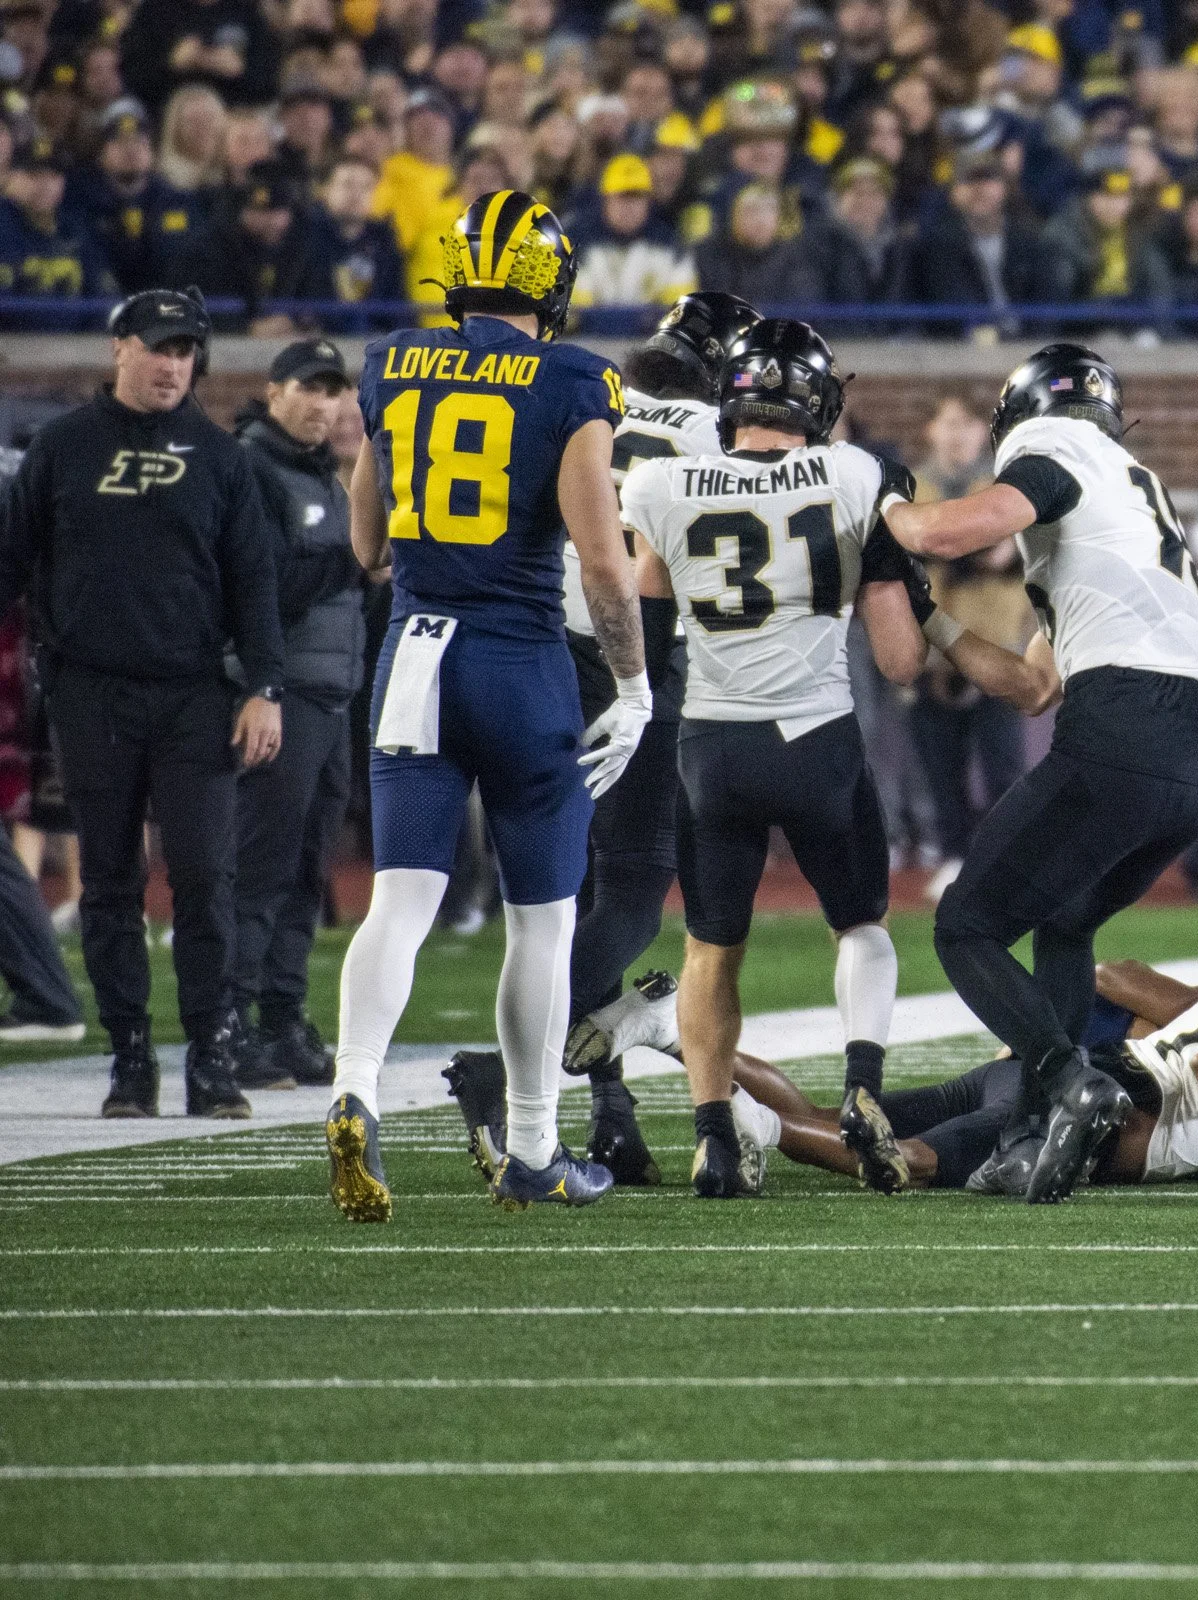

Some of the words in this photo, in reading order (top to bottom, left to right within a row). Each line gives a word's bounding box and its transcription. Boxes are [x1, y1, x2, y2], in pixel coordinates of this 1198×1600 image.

[383, 346, 541, 386] LOVELAND
[384, 389, 515, 546] 18
[683, 456, 829, 498] THIENEMAN
[685, 500, 842, 635] 31
[410, 617, 449, 640] M
